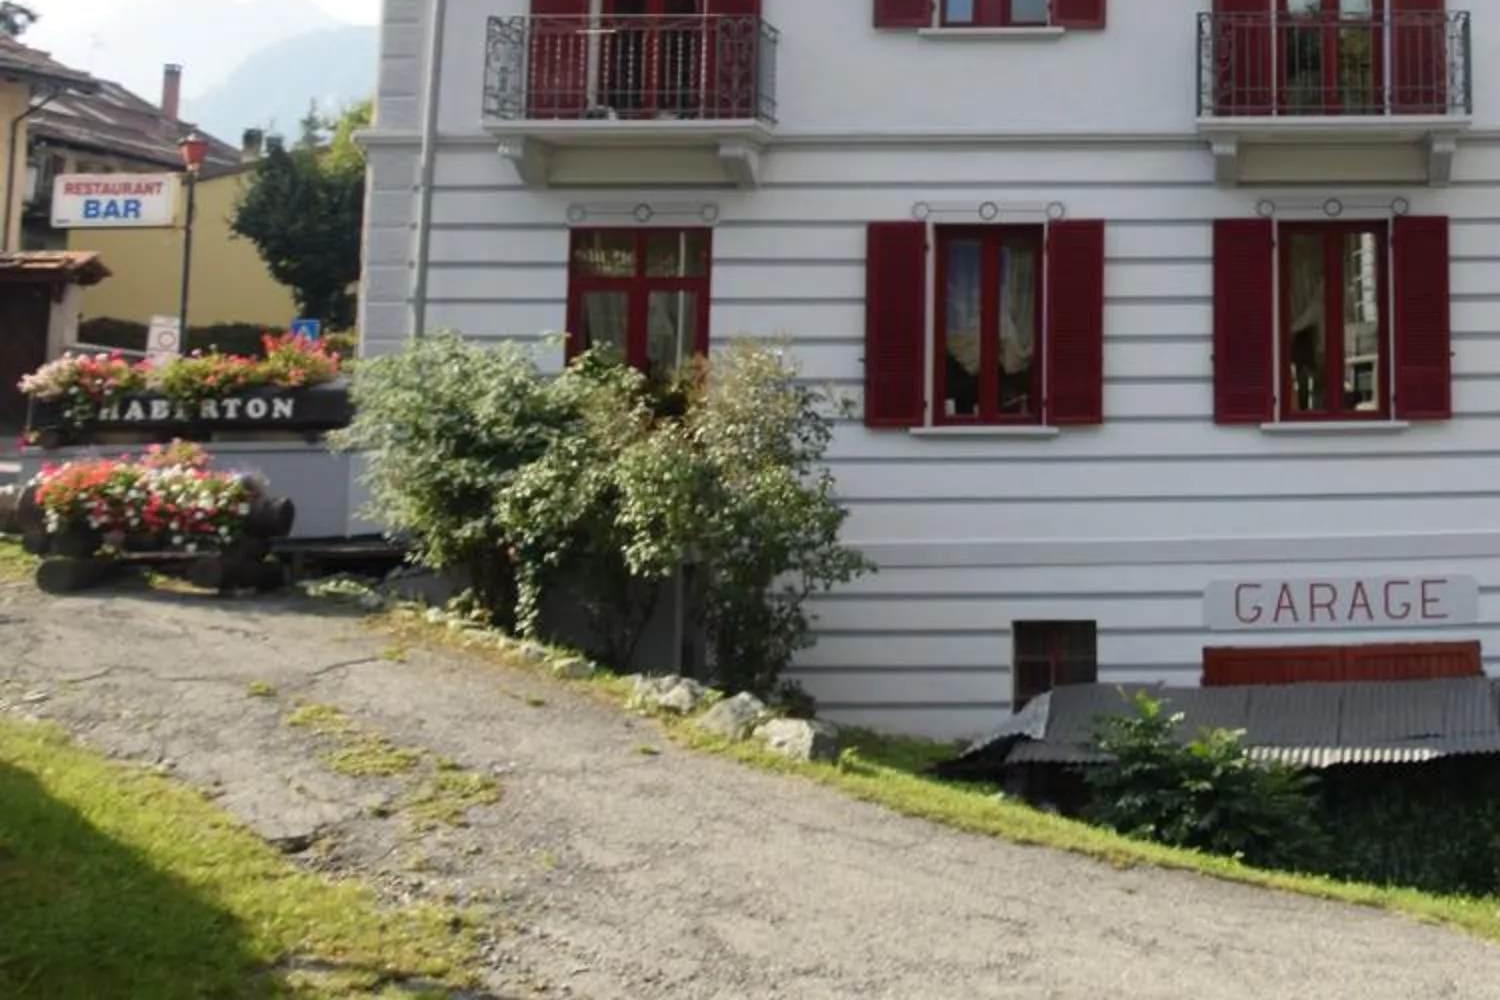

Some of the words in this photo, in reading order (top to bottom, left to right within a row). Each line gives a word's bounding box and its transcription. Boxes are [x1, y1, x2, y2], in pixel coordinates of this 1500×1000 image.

[64, 181, 164, 195] RESTAURANT
[84, 198, 141, 219] BAR
[97, 397, 295, 421] HABRTON
[1234, 579, 1449, 624] GARAGE
